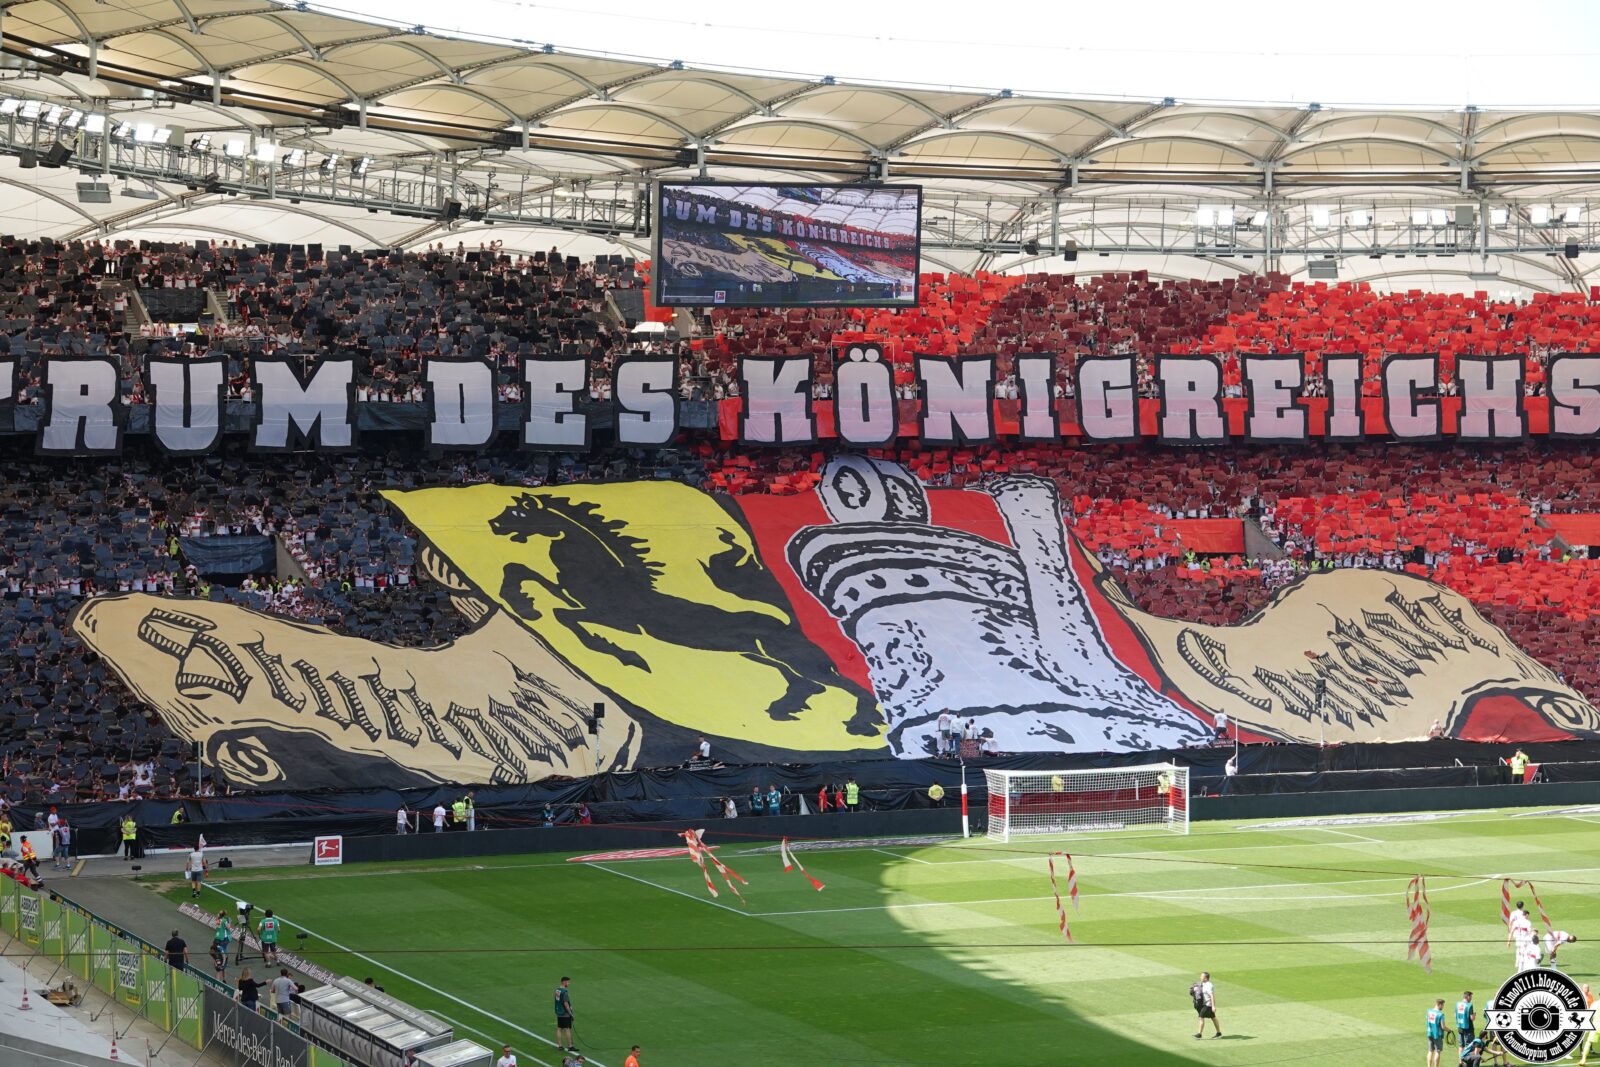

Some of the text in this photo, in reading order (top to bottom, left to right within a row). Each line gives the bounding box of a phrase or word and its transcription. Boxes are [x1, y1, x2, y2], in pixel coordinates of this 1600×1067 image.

[663, 197, 891, 249] UM DES KÖNIGREICHS
[0, 346, 1600, 452] RUM DES KÖNIGREICHS
[213, 1010, 271, 1067] Mercedes-Benz
